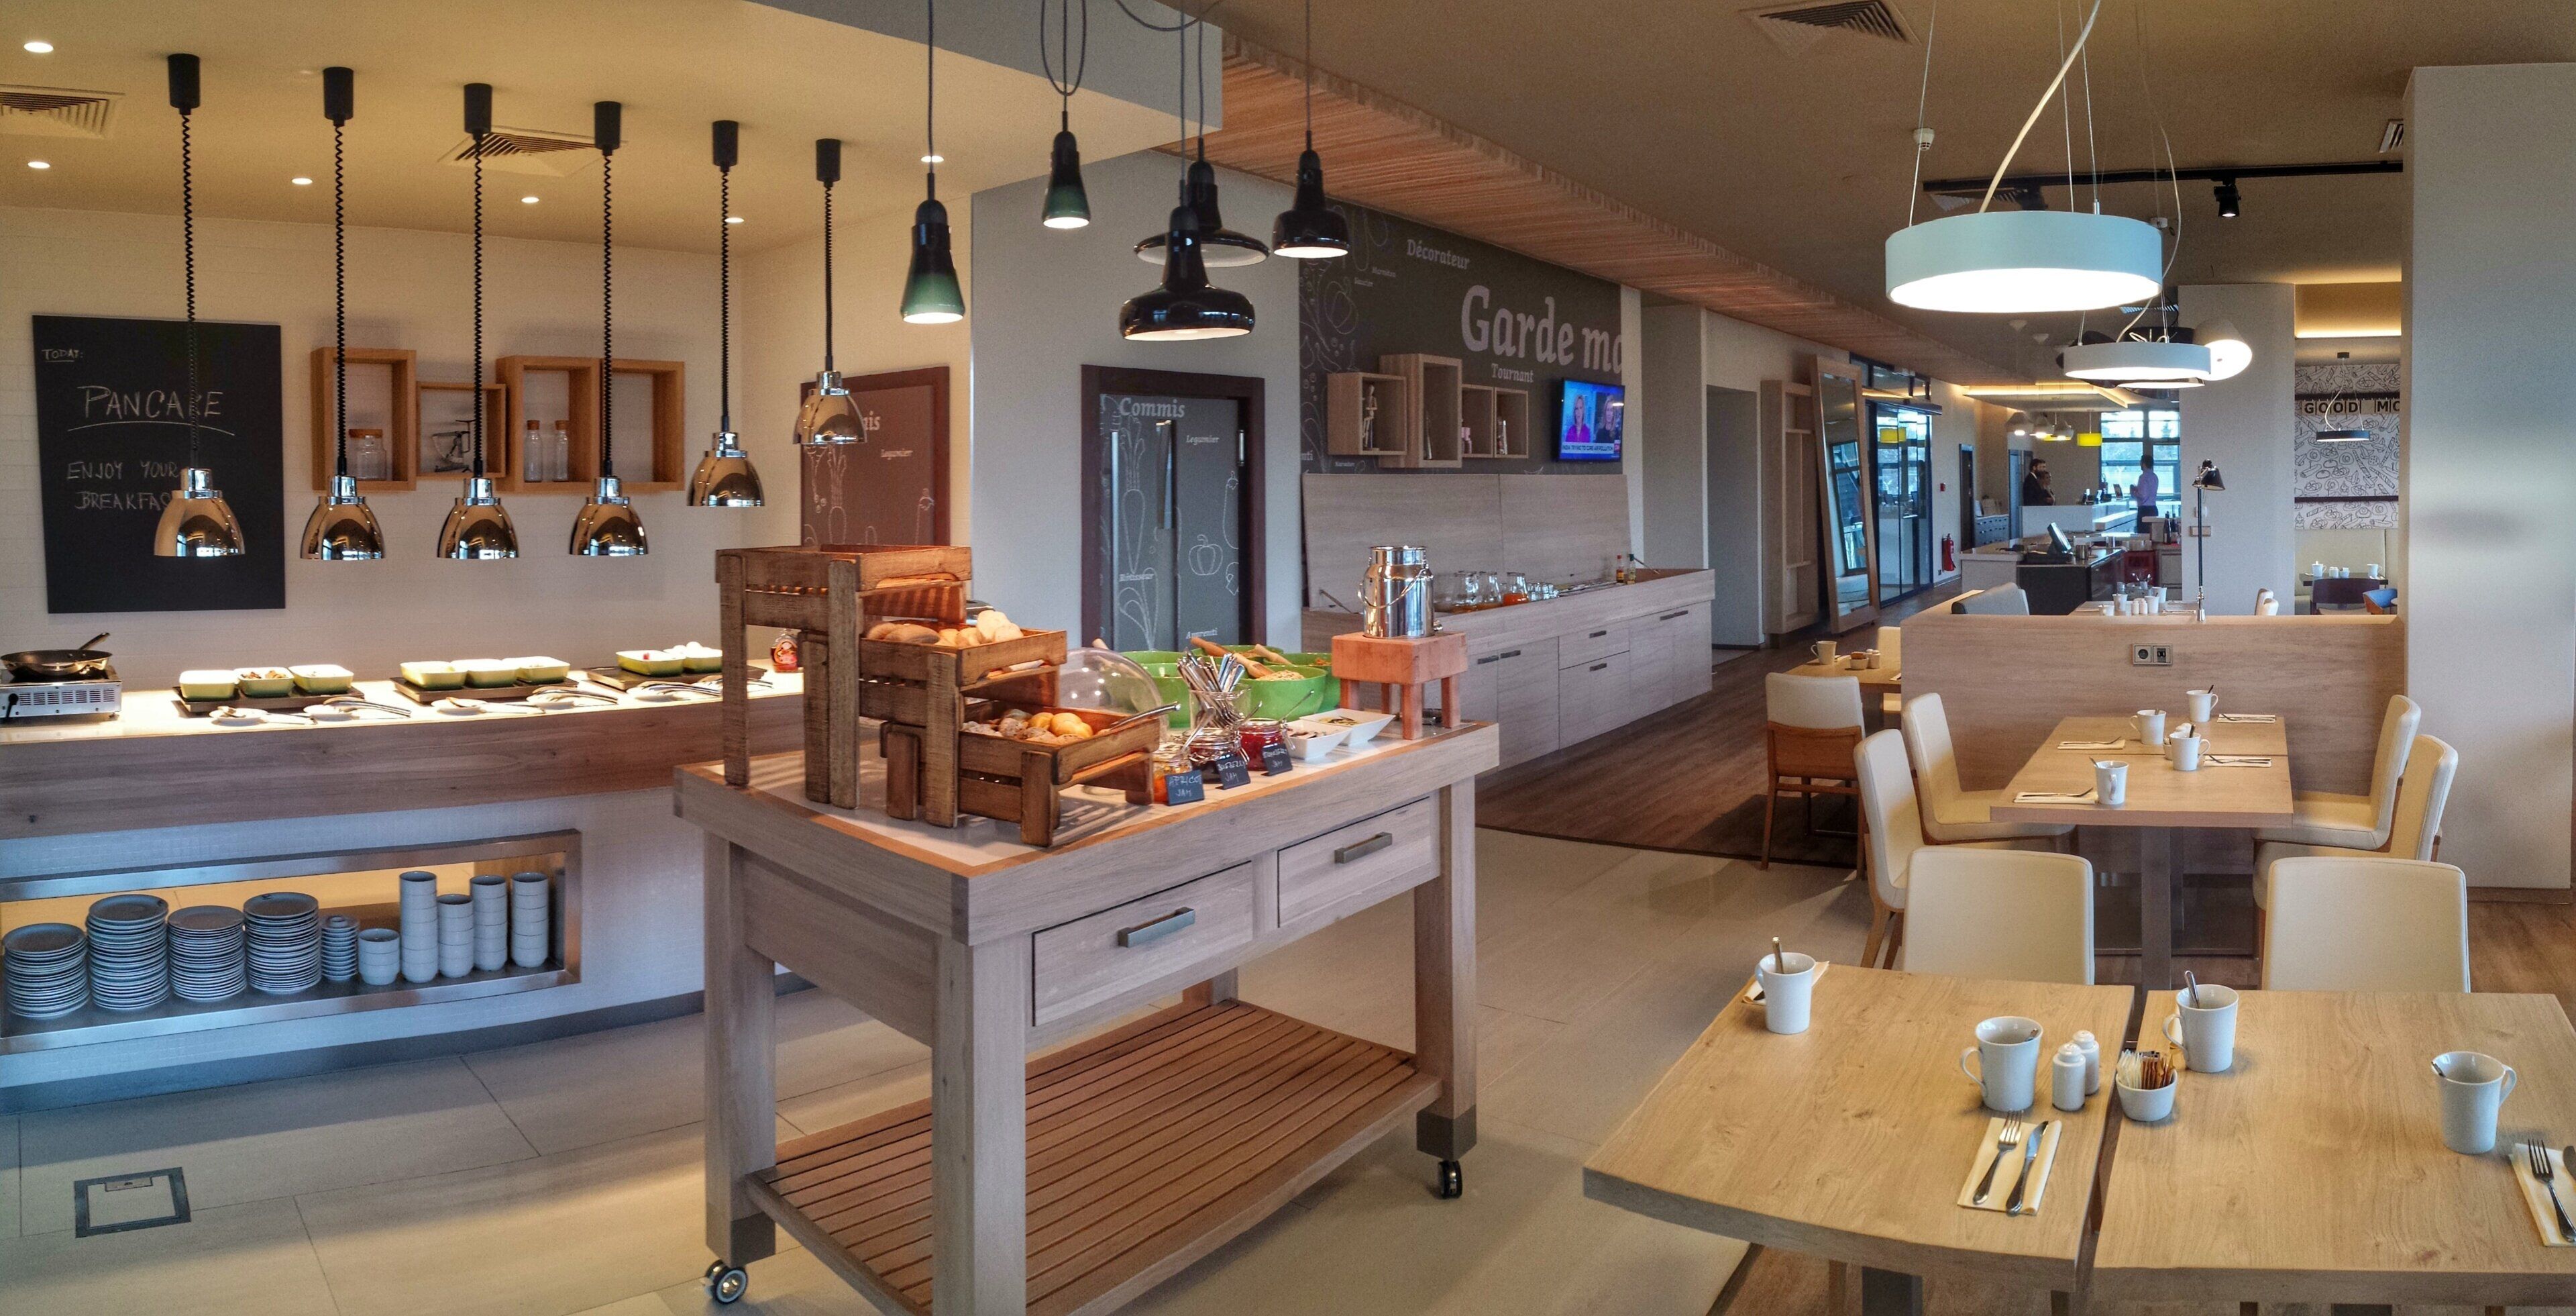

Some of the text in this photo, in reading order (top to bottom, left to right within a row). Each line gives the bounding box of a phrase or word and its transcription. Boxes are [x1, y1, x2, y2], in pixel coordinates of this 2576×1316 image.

[1407, 239, 1470, 270] Décorateur
[1461, 285, 1574, 366] Garde
[1491, 363, 1534, 383] Tournant
[1119, 397, 1186, 418] Commis
[2304, 402, 2359, 413] GOOD
[66, 460, 180, 480] ENJOY YOUR
[1176, 789, 1193, 797] JAM
